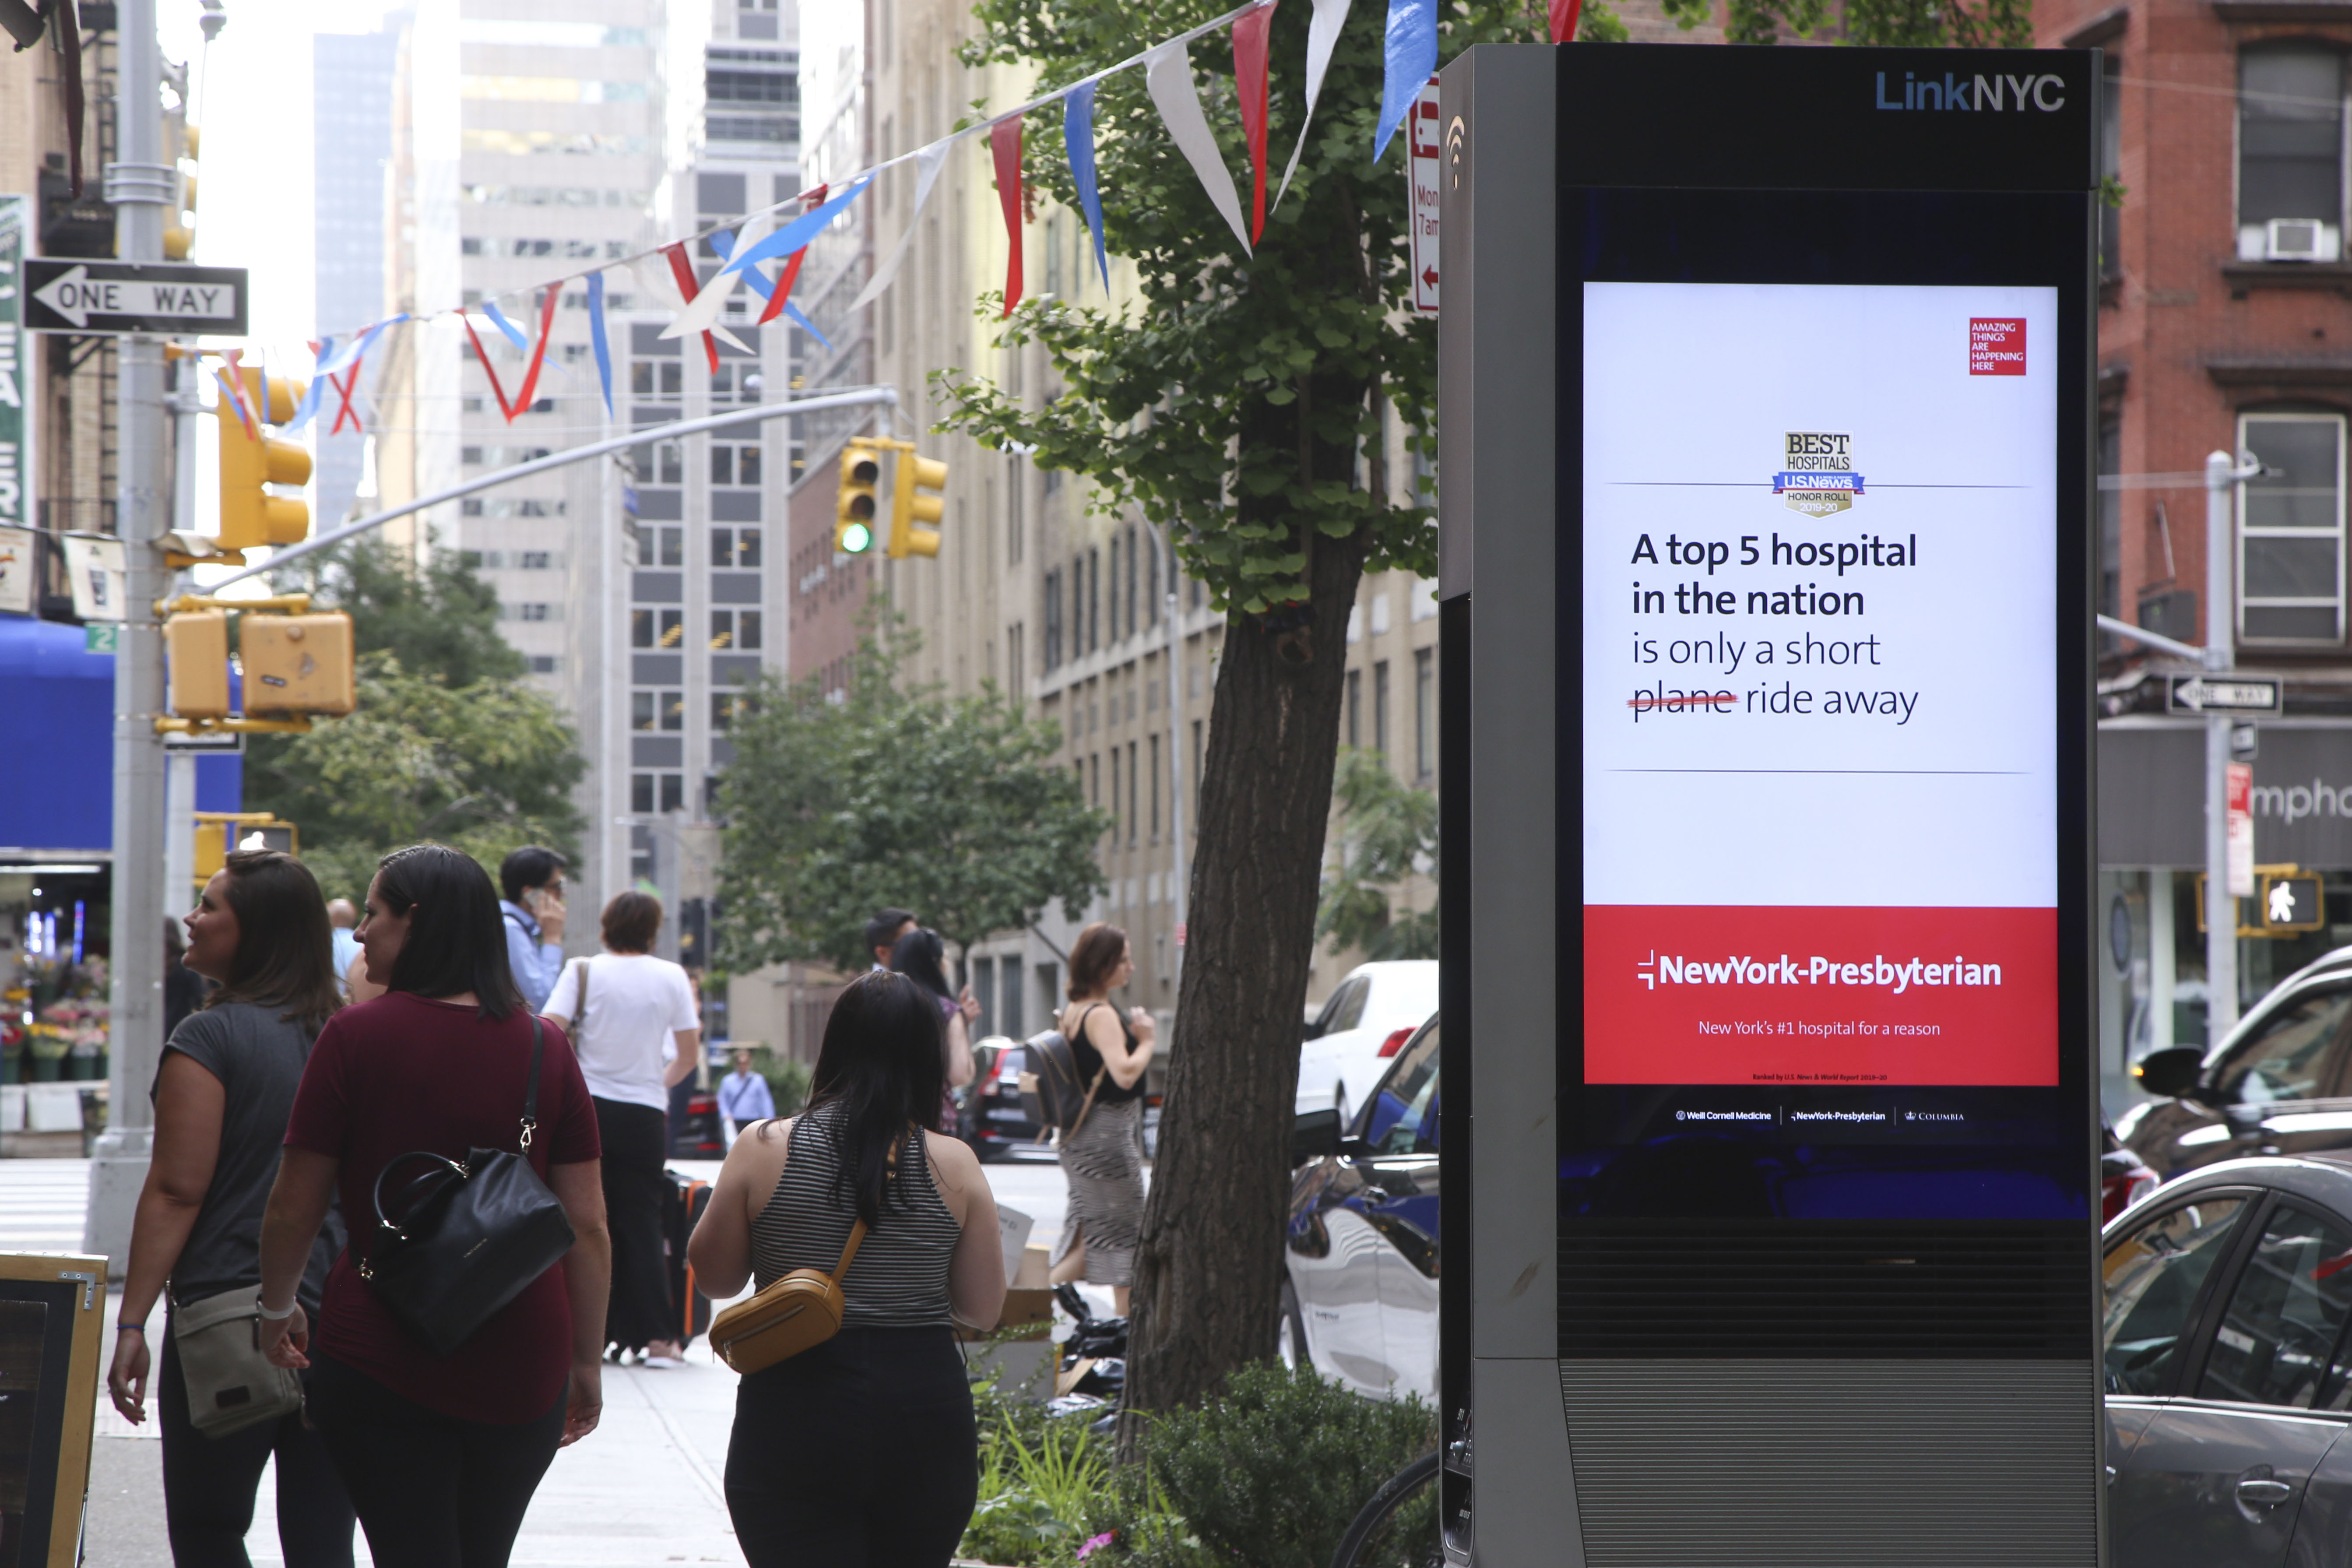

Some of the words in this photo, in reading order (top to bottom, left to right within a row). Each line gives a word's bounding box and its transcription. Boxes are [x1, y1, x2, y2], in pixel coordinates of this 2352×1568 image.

[1877, 73, 2064, 111] LinkNYC
[58, 283, 120, 310] ONE
[153, 287, 219, 313] WAY
[1972, 323, 2015, 331] AMAZING
[1972, 333, 2005, 341] THINGS
[1972, 342, 1989, 351] ARE
[1972, 352, 2023, 361] HAPPENING
[1972, 362, 1994, 370] HERE
[1788, 434, 1849, 454] BEST
[1788, 457, 1849, 470] HOSPITALS
[1800, 503, 1838, 512] 2019-20
[1631, 534, 1658, 564] A
[1666, 534, 1729, 575] top
[1741, 536, 1759, 565] 5
[1772, 533, 1915, 576] hospital
[1633, 582, 1664, 613] in
[1674, 582, 1736, 614] the
[1748, 583, 1863, 615] nation
[1634, 632, 1658, 663] is
[1670, 631, 1746, 675] only
[1756, 641, 1772, 664] a
[1787, 632, 1880, 664] short
[2188, 686, 2217, 699] ONE
[2235, 687, 2266, 700] WAY
[1635, 680, 1732, 723] plane
[1748, 681, 1812, 714] ride
[1824, 691, 1918, 725] away
[1660, 955, 2000, 994] NewYork-Presbyterian
[1700, 1021, 1731, 1034] New
[1778, 1022, 1794, 1034] #1
[1799, 1021, 1854, 1038] hospital
[1859, 1021, 1878, 1034] for
[1882, 1025, 1889, 1035] a
[1895, 1025, 1940, 1035] reason
[1707, 1111, 1734, 1120] Cornell
[1736, 1111, 1771, 1120] Medicine
[1797, 1111, 1885, 1122] NewYork-Presbyterian
